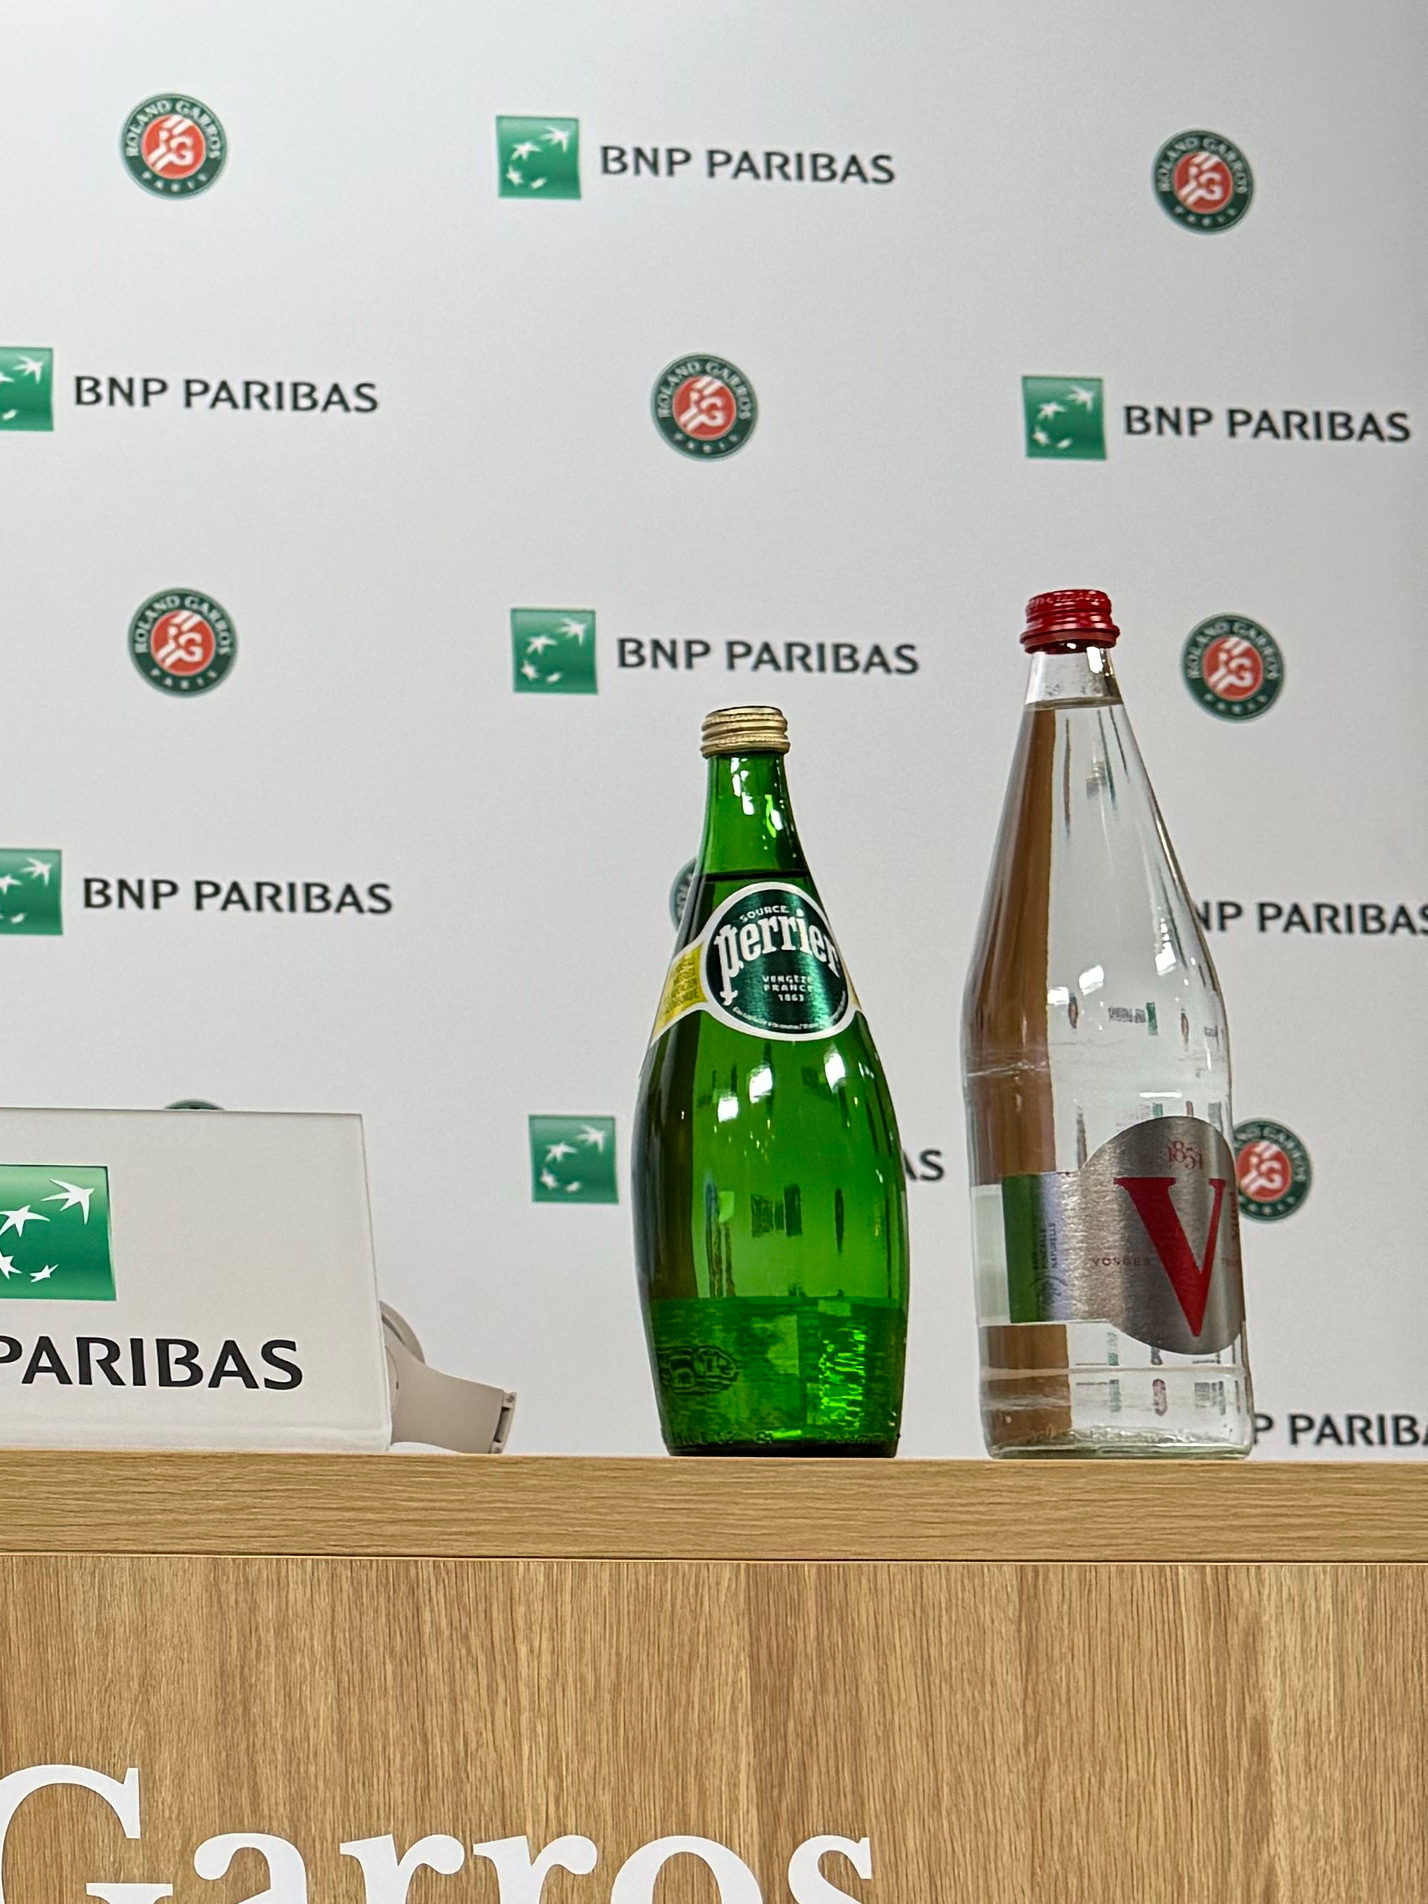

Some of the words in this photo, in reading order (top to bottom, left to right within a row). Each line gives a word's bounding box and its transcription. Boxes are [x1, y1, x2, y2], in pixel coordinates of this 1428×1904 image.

[601, 145, 692, 177] BNP
[707, 149, 895, 185] PARIBAS
[75, 375, 168, 408] BNP
[184, 378, 378, 413] PARIBAS
[1124, 405, 1213, 437] BNP
[1227, 408, 1411, 443] PARIBAS
[617, 637, 711, 670] BNP
[726, 640, 919, 675] PARIBAS
[83, 877, 179, 910] BNP
[194, 880, 393, 915] PARIBAS
[739, 905, 791, 923] SOURCE
[1112, 1176, 1228, 1339] V
[1287, 1413, 1428, 1447] PARIB
